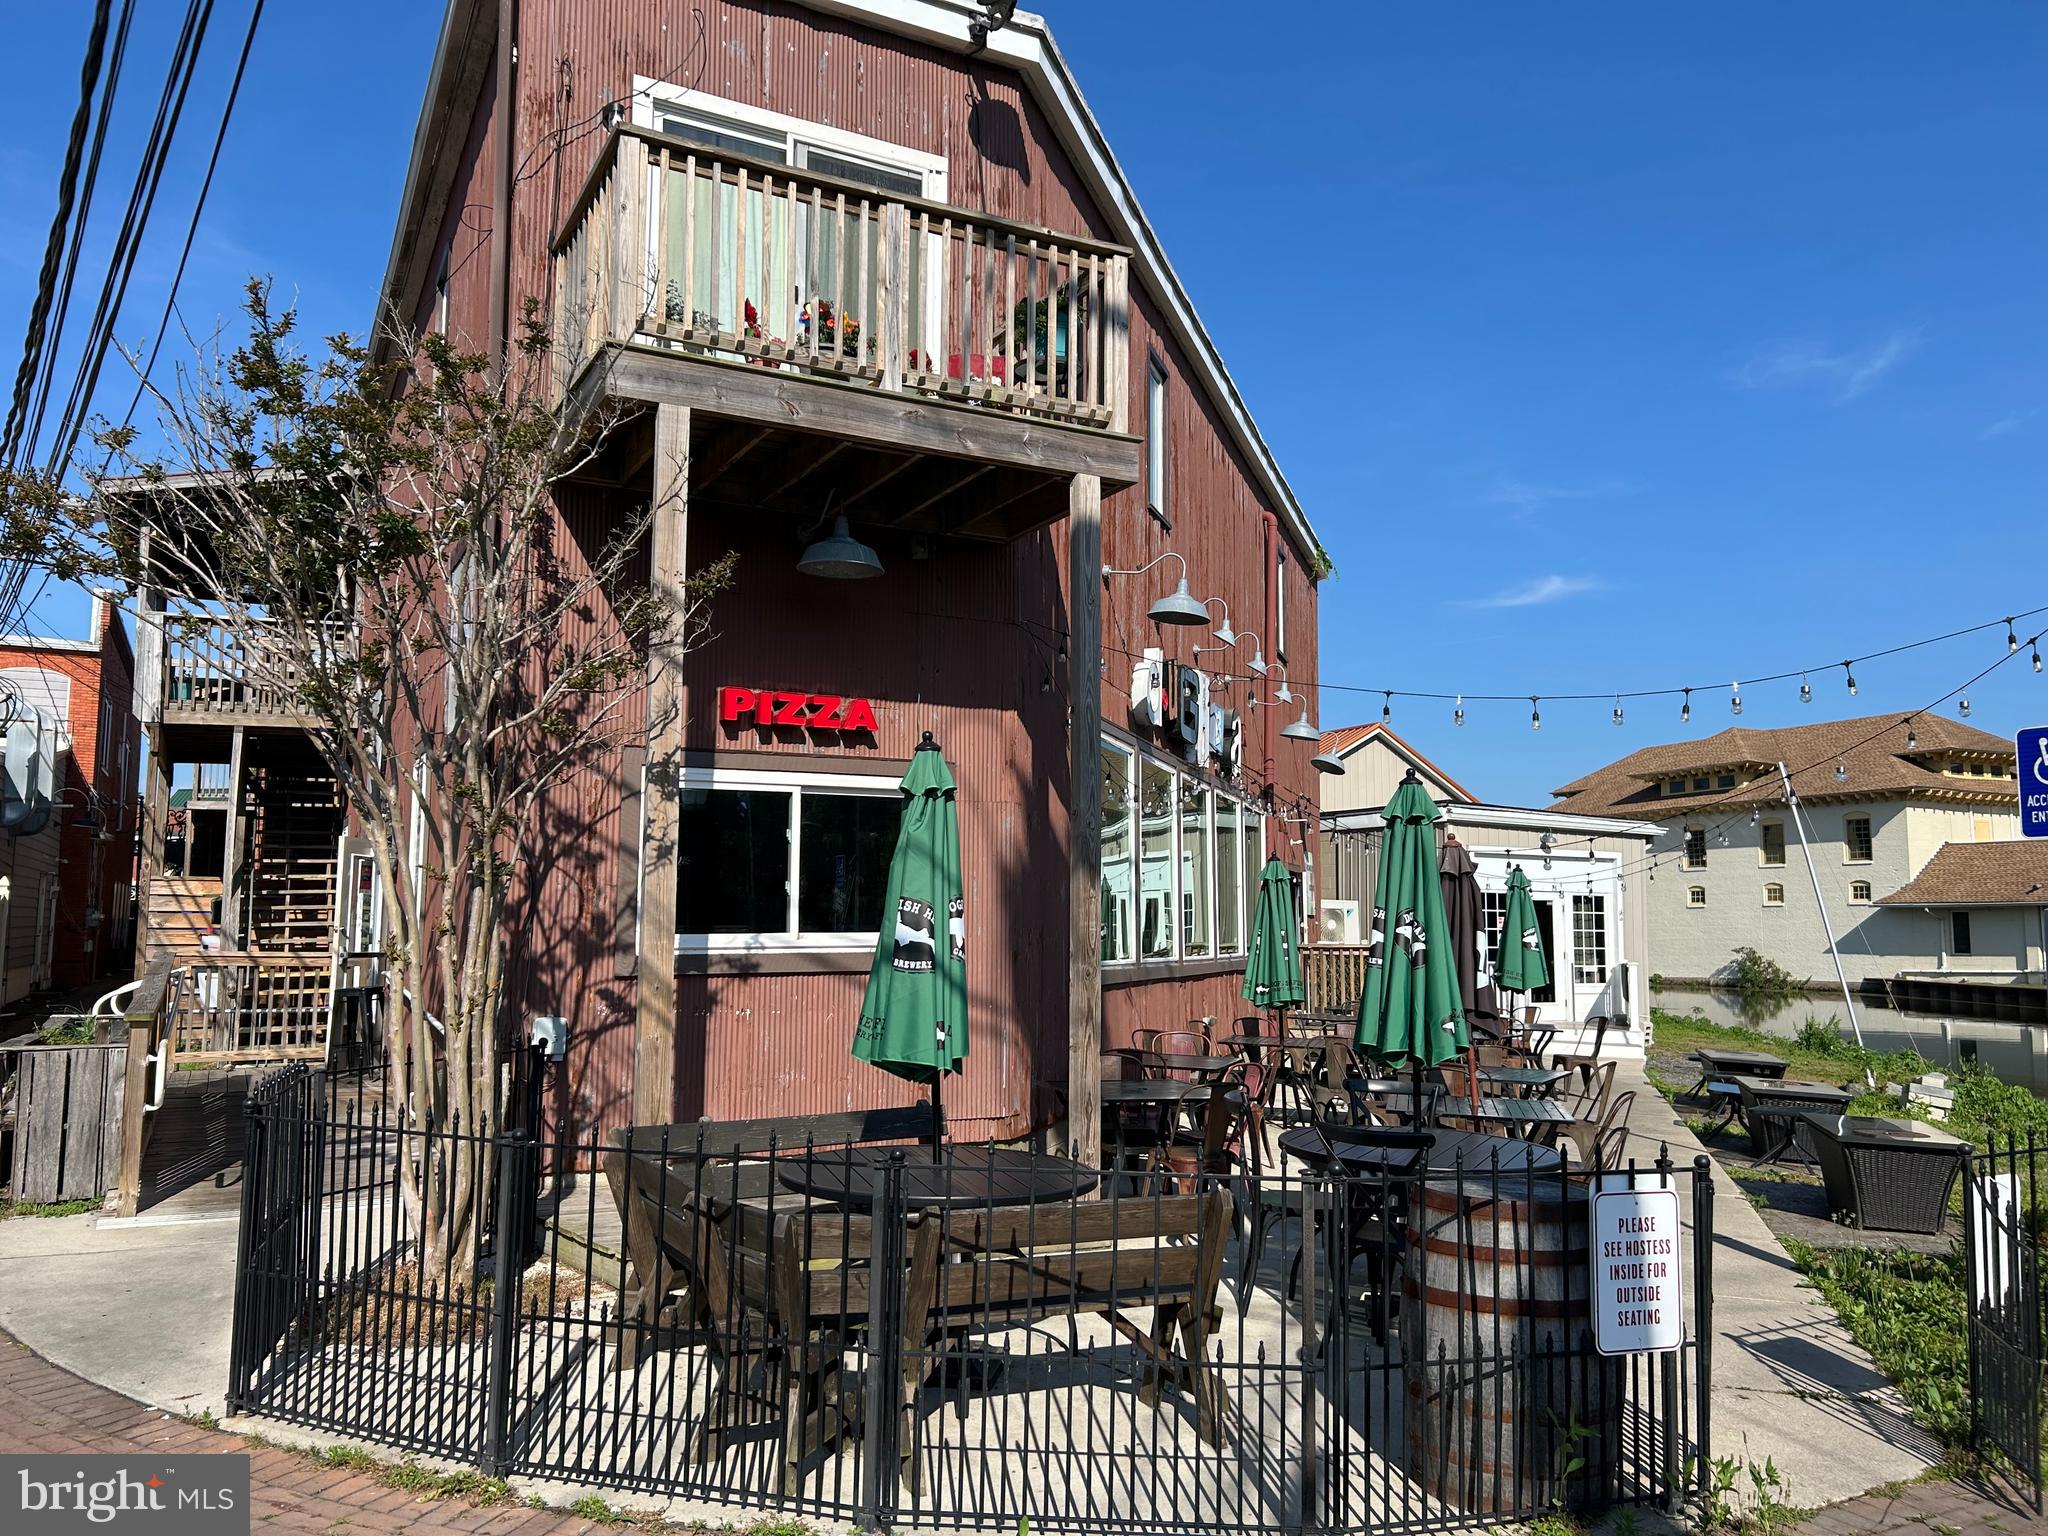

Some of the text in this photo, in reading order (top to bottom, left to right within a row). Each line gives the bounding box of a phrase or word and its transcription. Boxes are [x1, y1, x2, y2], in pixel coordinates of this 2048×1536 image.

[720, 686, 879, 731] PIZZA
[2027, 794, 2048, 807] ACC
[893, 958, 932, 969] BREWERY
[1618, 1216, 1656, 1234] PLEASE
[1604, 1238, 1671, 1258] SEE HOSTESS
[1609, 1262, 1667, 1280] INSIDE FOR
[1616, 1285, 1661, 1304] OUTSIDE
[1617, 1308, 1661, 1327] SEATING
